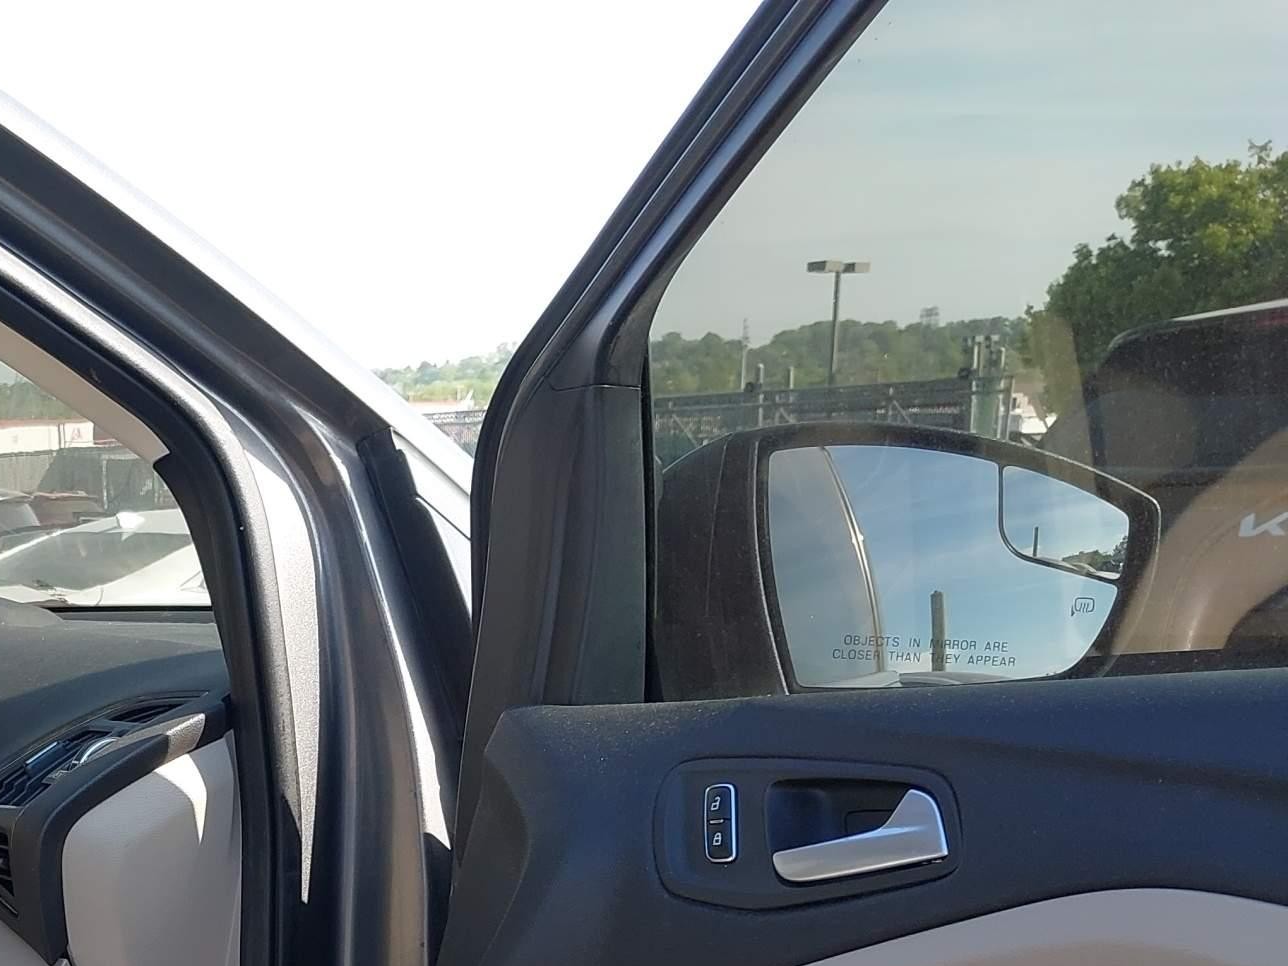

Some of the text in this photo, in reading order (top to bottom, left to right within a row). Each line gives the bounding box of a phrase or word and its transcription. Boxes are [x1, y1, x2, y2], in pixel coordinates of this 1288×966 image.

[843, 634, 1009, 653] OBJECTS IN MIRROR ARE
[832, 648, 1016, 667] CLOSER THAN THEY APPEAR
